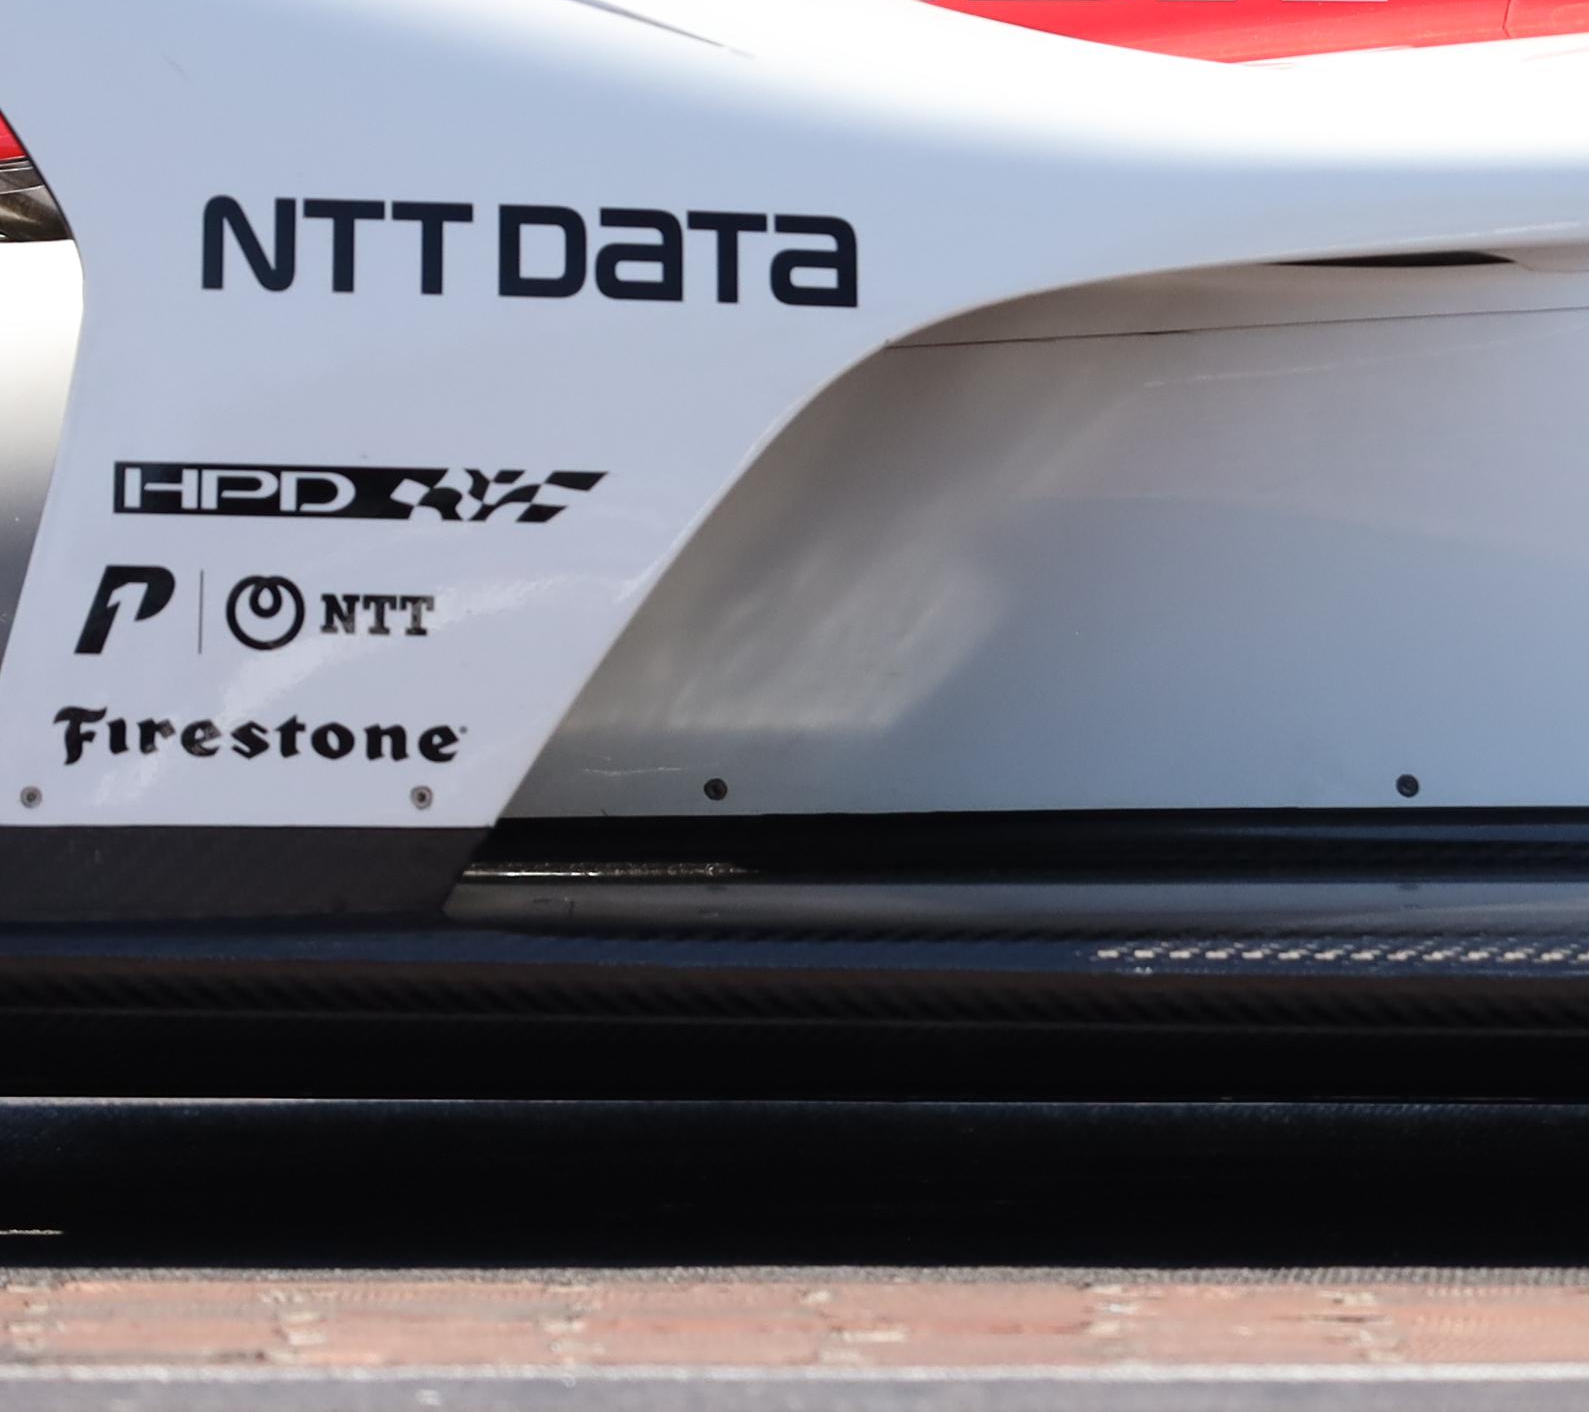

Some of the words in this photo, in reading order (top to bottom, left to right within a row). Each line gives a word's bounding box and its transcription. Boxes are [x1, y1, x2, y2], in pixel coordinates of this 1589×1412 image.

[202, 193, 474, 296] NTT
[123, 467, 356, 513] HPD
[320, 593, 435, 637] NTT
[53, 705, 463, 766] Firestone
